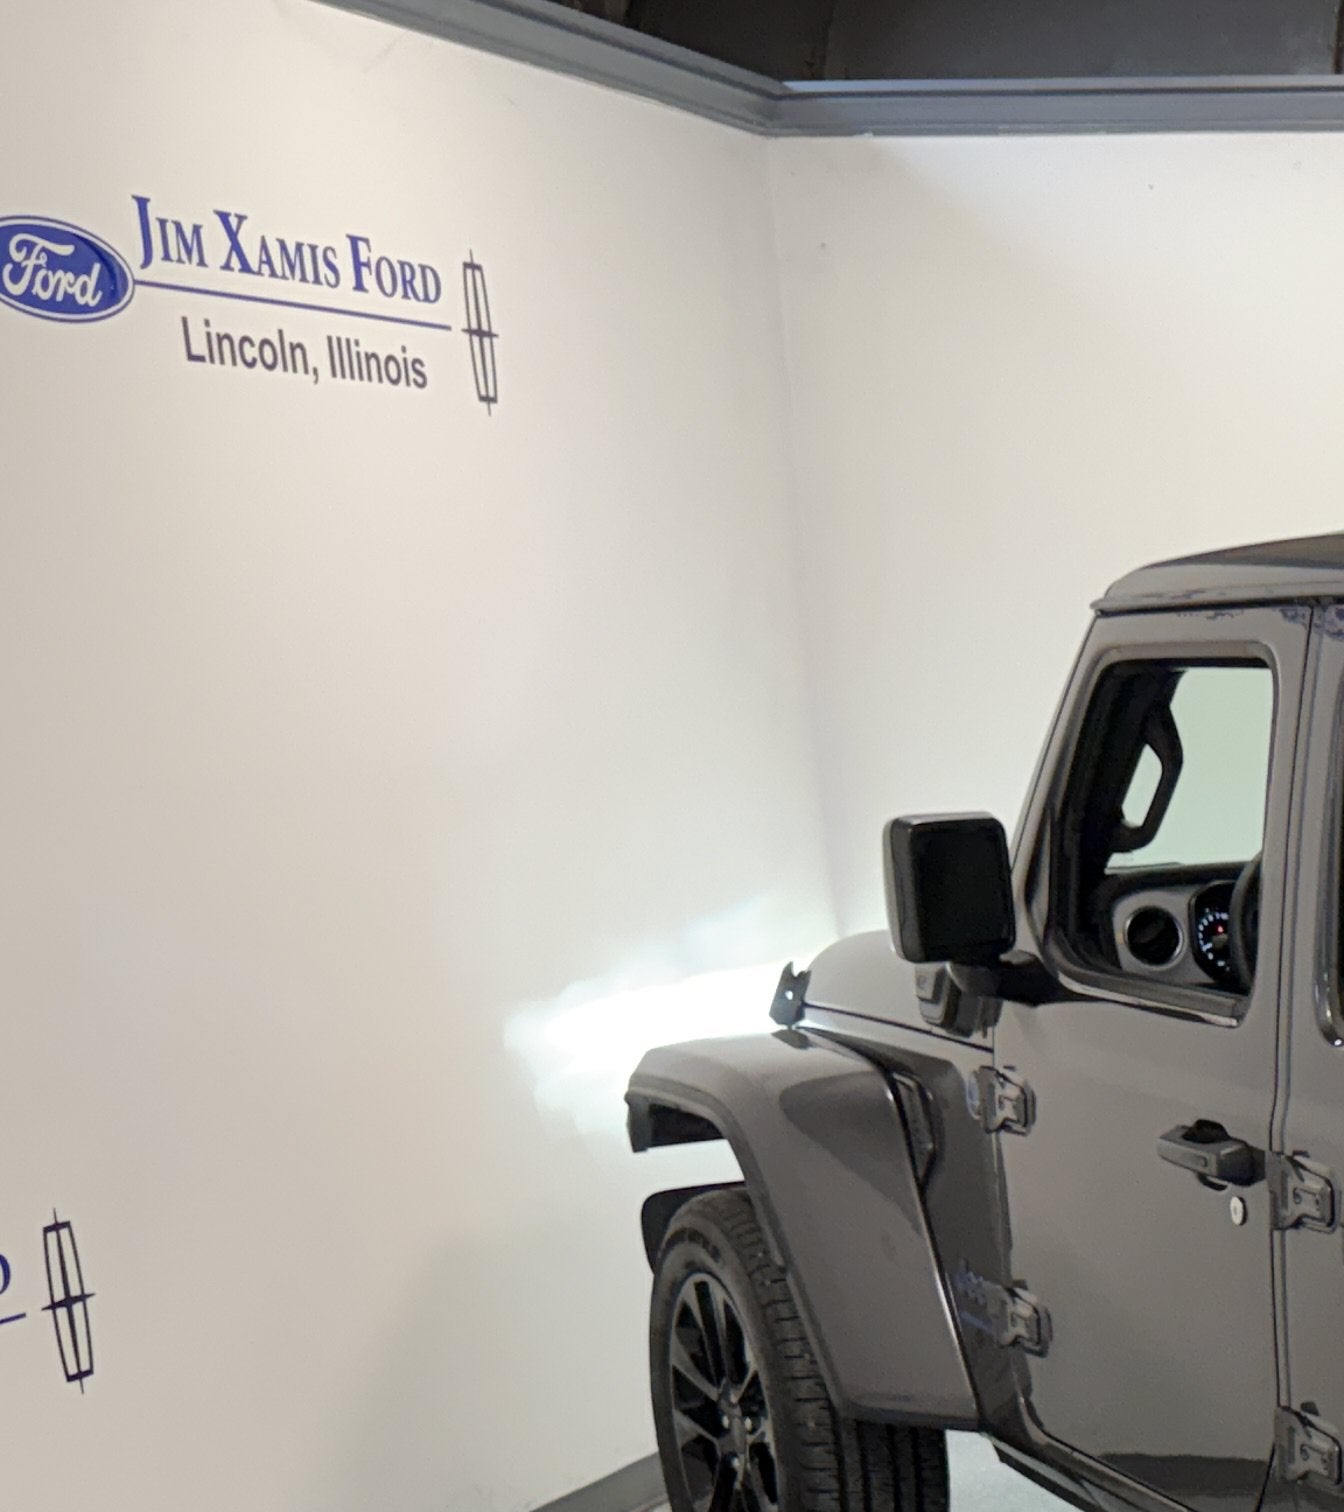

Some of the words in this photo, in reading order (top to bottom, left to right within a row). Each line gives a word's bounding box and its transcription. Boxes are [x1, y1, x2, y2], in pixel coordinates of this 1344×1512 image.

[2, 232, 103, 308] Ford
[131, 195, 208, 269] JIM
[214, 209, 342, 290] XAMIS
[346, 234, 443, 304] FORD
[181, 316, 320, 385] Lincoln,
[327, 334, 429, 389] Illinois
